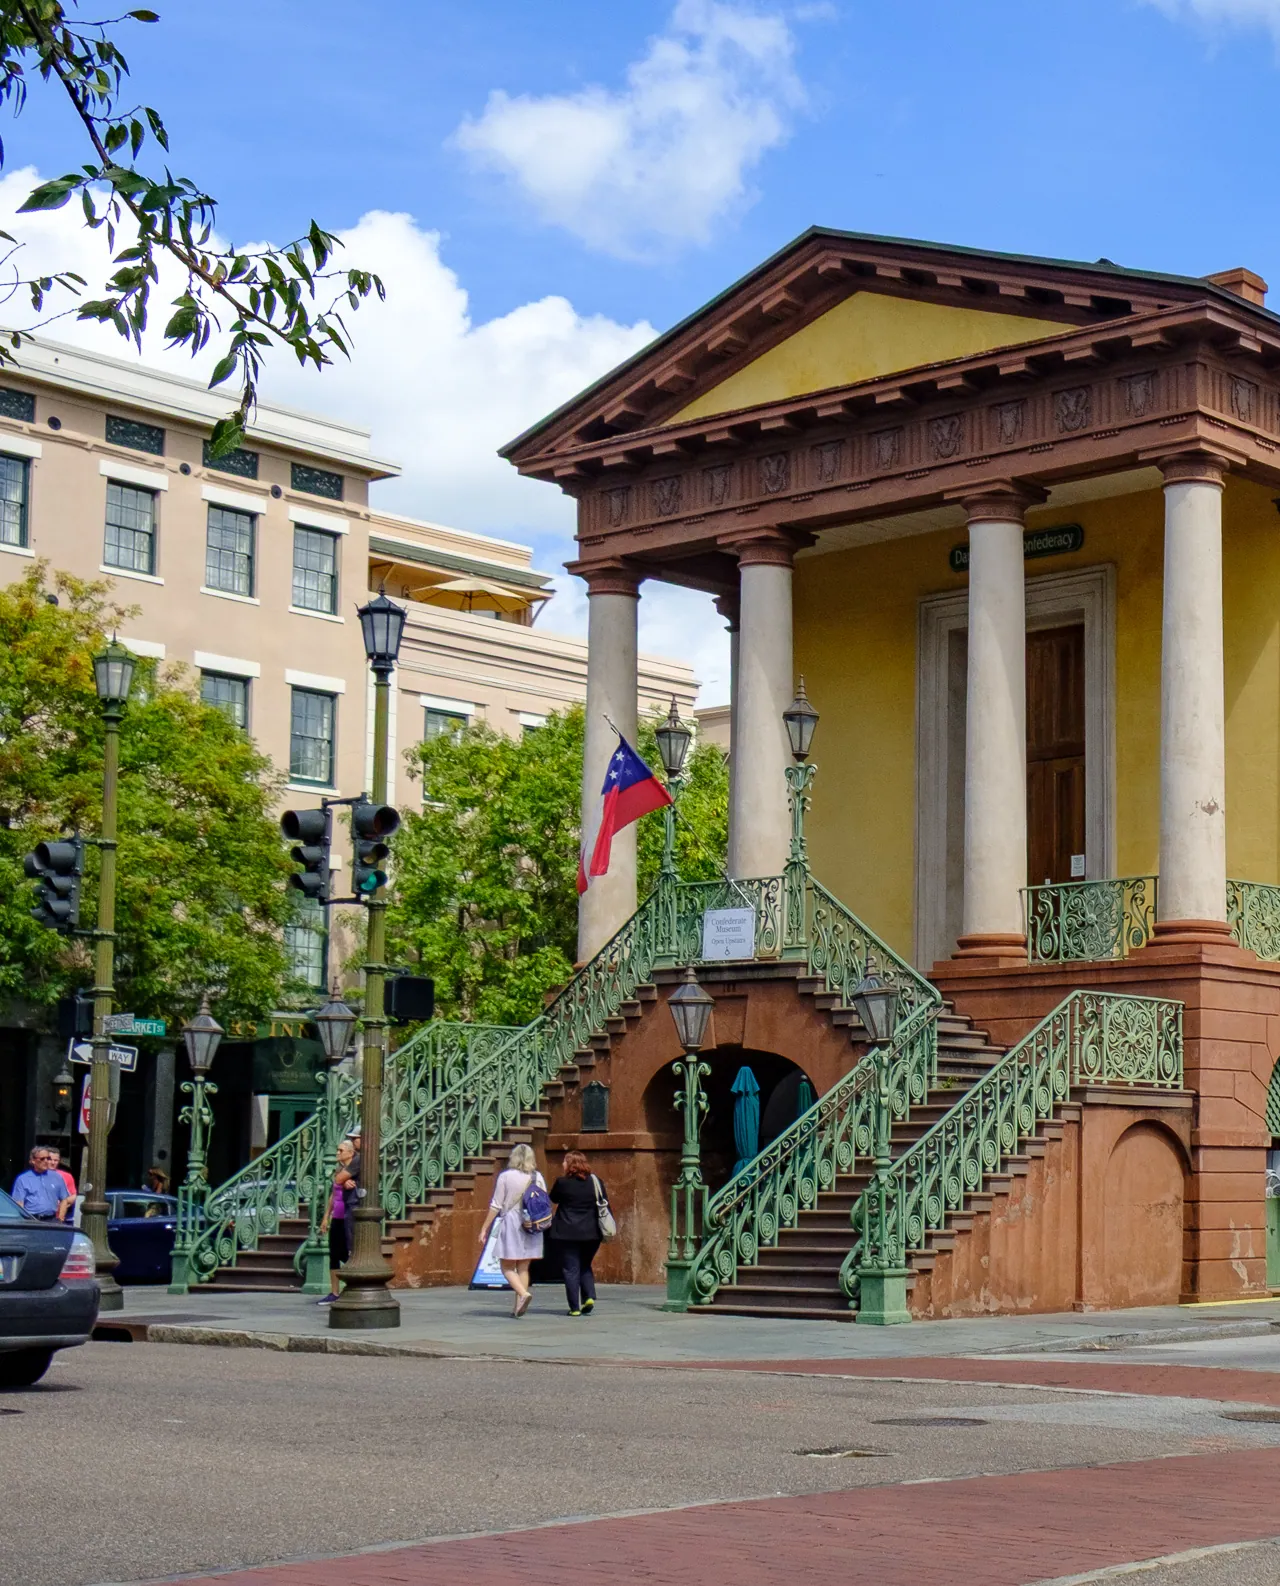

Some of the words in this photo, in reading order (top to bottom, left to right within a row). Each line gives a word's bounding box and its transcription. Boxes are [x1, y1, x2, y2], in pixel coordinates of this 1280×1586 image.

[1023, 532, 1074, 553] onfederacy
[711, 917, 746, 925] Confederate
[716, 925, 741, 933] Museum
[128, 1021, 158, 1034] ARKET
[156, 1025, 165, 1033] ST
[111, 1051, 129, 1063] WAY
